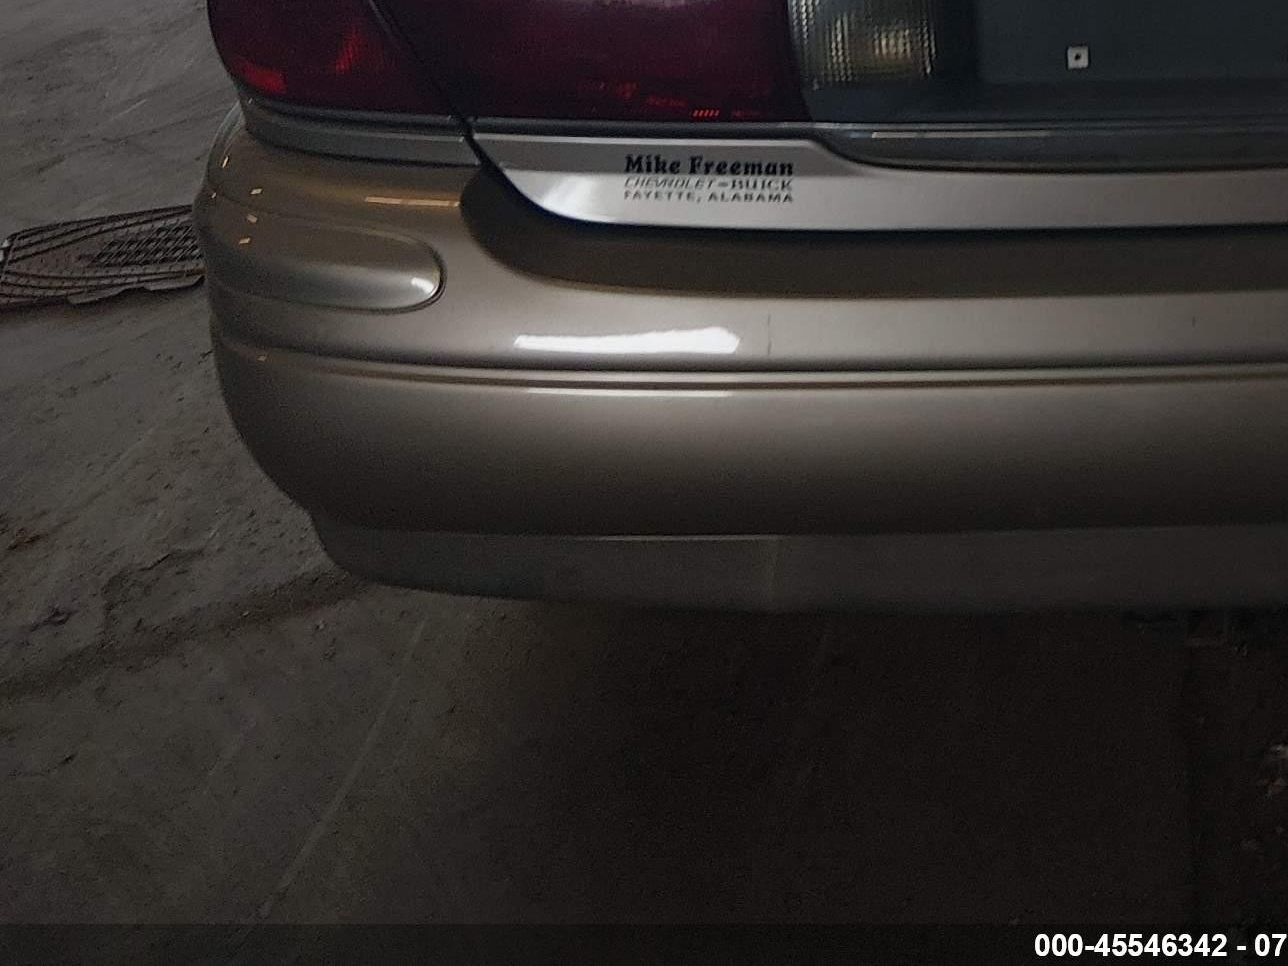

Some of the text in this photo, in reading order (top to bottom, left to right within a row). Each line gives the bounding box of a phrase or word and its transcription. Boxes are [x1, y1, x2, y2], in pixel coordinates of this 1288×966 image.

[624, 154, 793, 176] Mike Freeman
[624, 190, 793, 203] FAYETTE, ALABAMA
